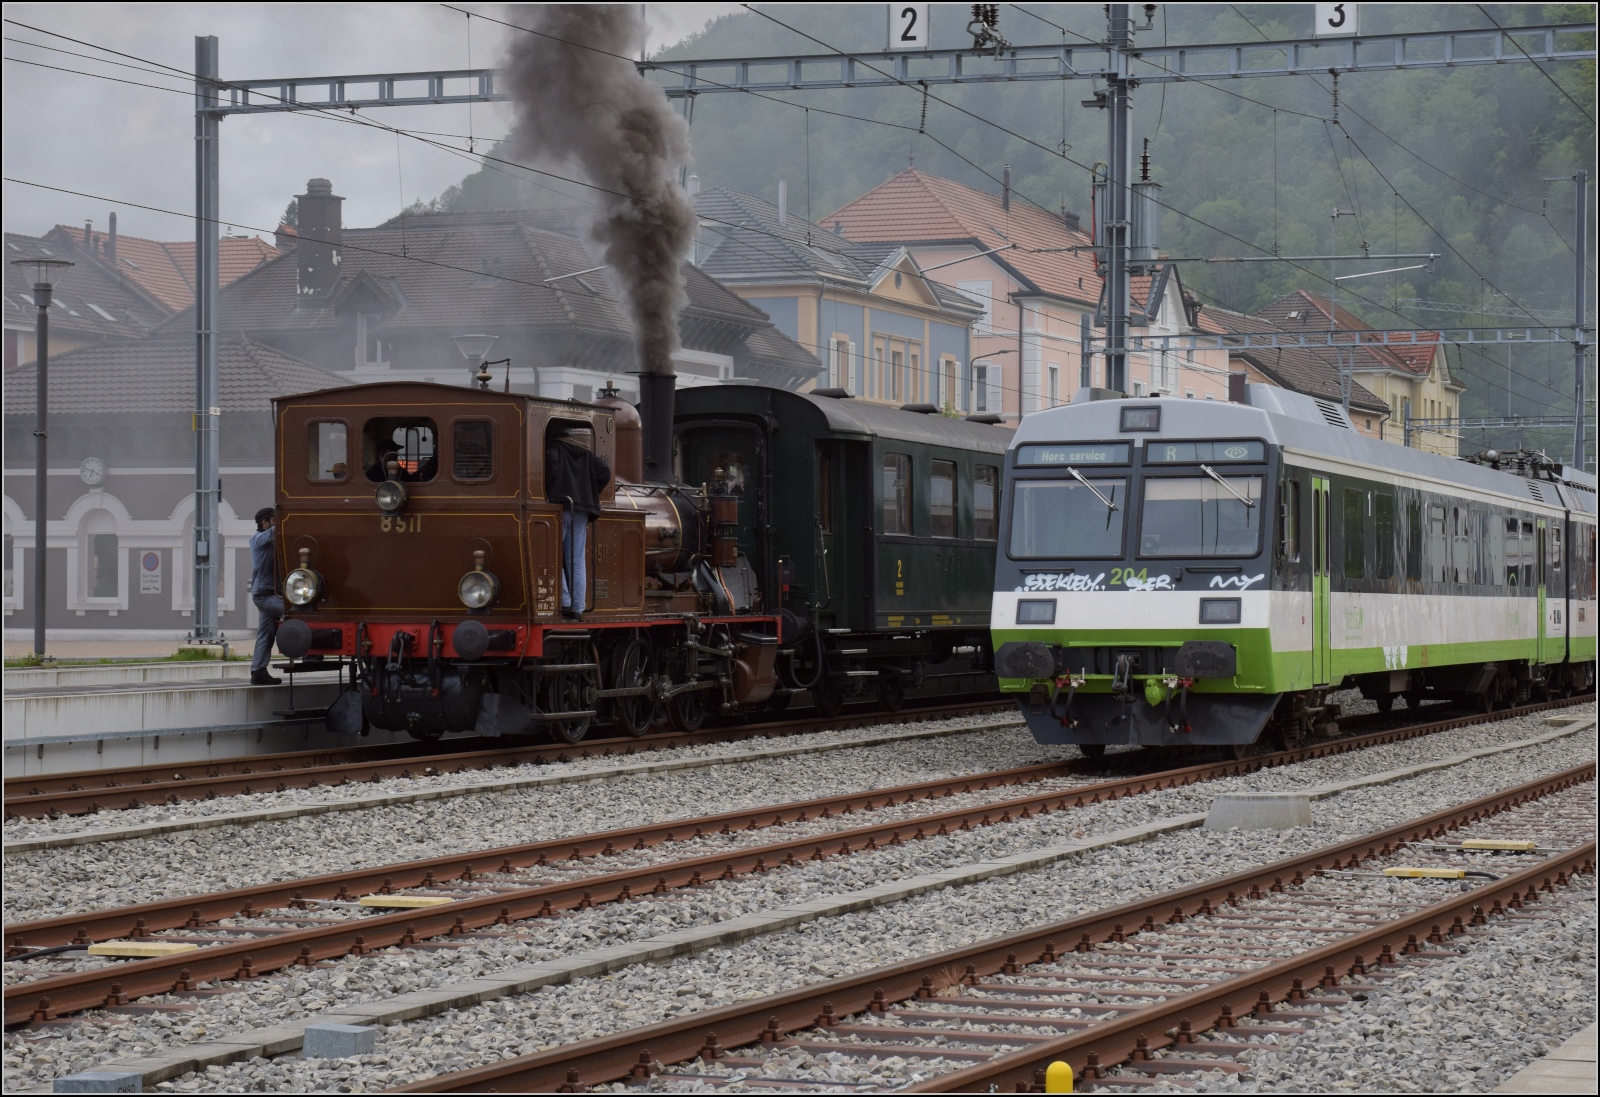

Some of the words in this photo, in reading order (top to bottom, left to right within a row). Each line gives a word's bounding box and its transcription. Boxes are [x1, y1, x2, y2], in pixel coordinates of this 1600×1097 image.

[901, 7, 917, 41] 2
[1328, 4, 1345, 28] 3
[1042, 450, 1065, 462] Hors
[1069, 447, 1106, 461] service
[1166, 446, 1176, 461] R
[380, 513, 421, 533] 8511
[897, 559, 902, 577] 2
[1110, 567, 1148, 585] 204
